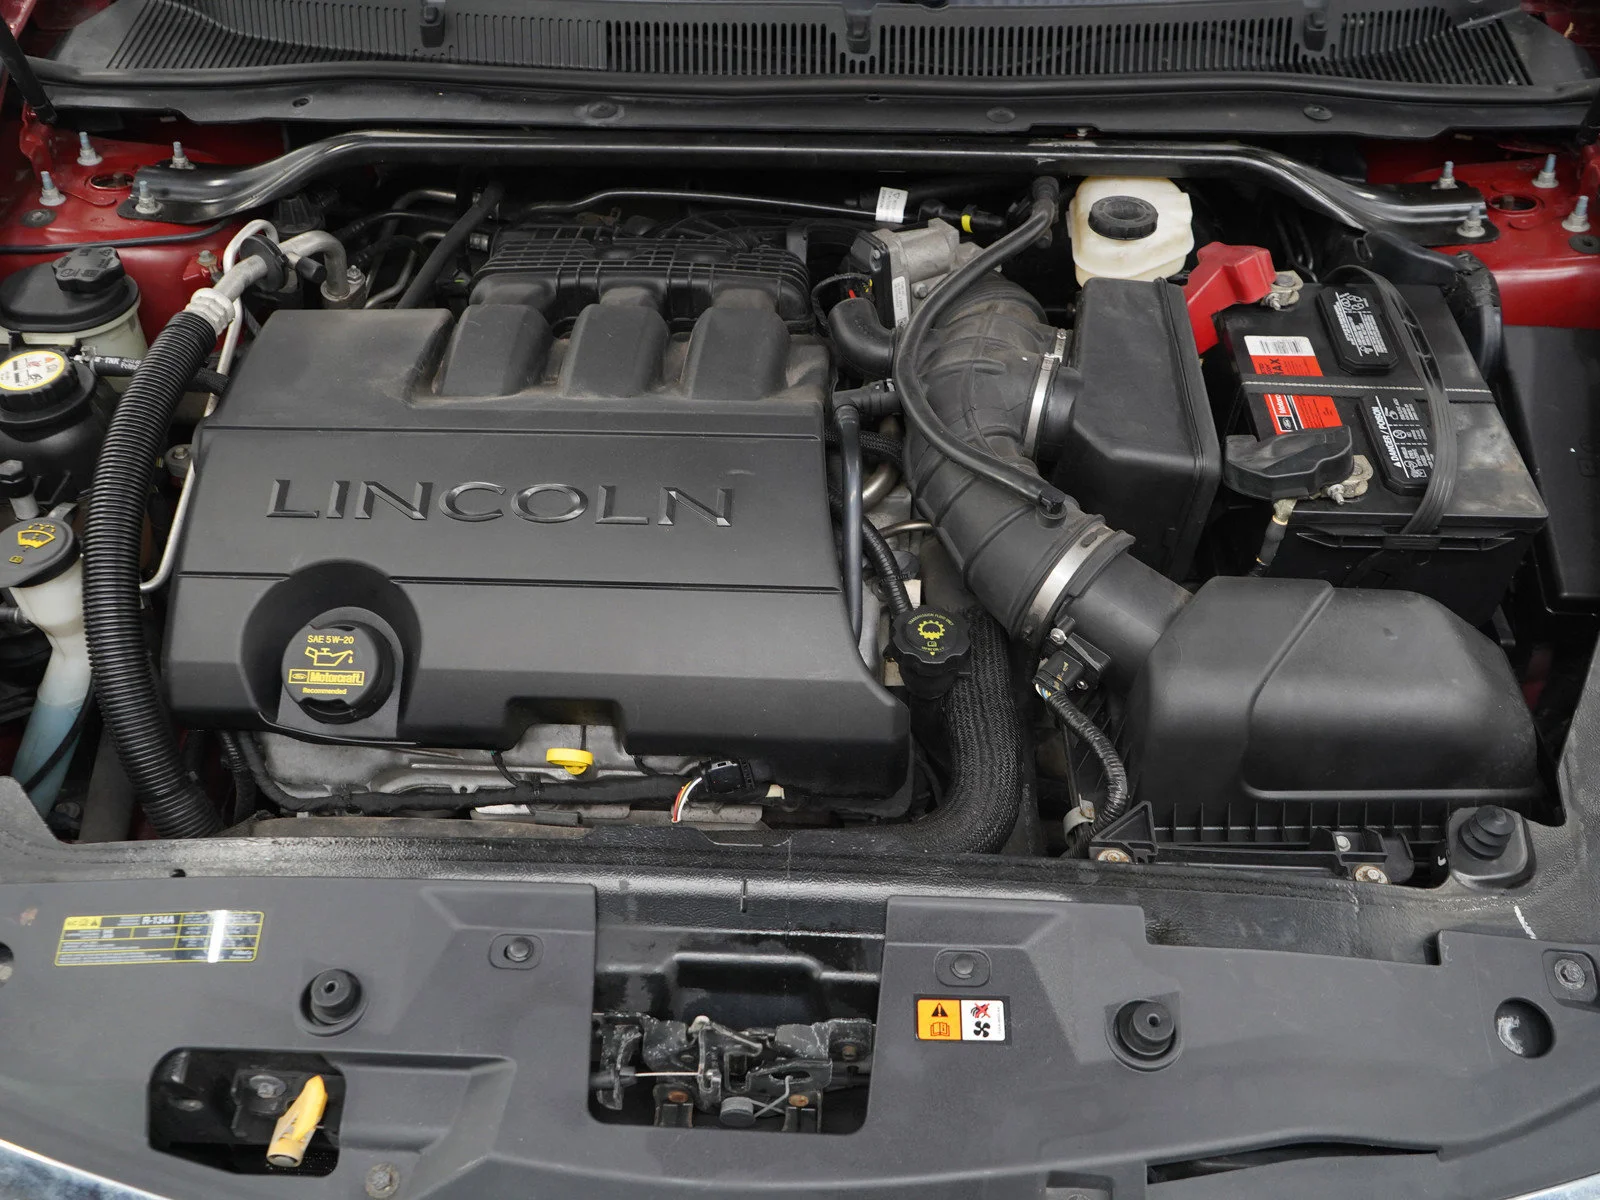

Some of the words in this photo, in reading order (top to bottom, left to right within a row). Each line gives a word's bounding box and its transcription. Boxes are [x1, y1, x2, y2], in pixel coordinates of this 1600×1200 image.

[1275, 394, 1287, 414] Motorc
[1371, 406, 1388, 430] POISON
[1382, 434, 1400, 461] DANGER
[266, 479, 733, 527] LINCOLN
[307, 634, 325, 644] SAE
[326, 635, 354, 644] 5W-20
[302, 687, 348, 695] Recommended
[141, 915, 175, 925] R-134A
